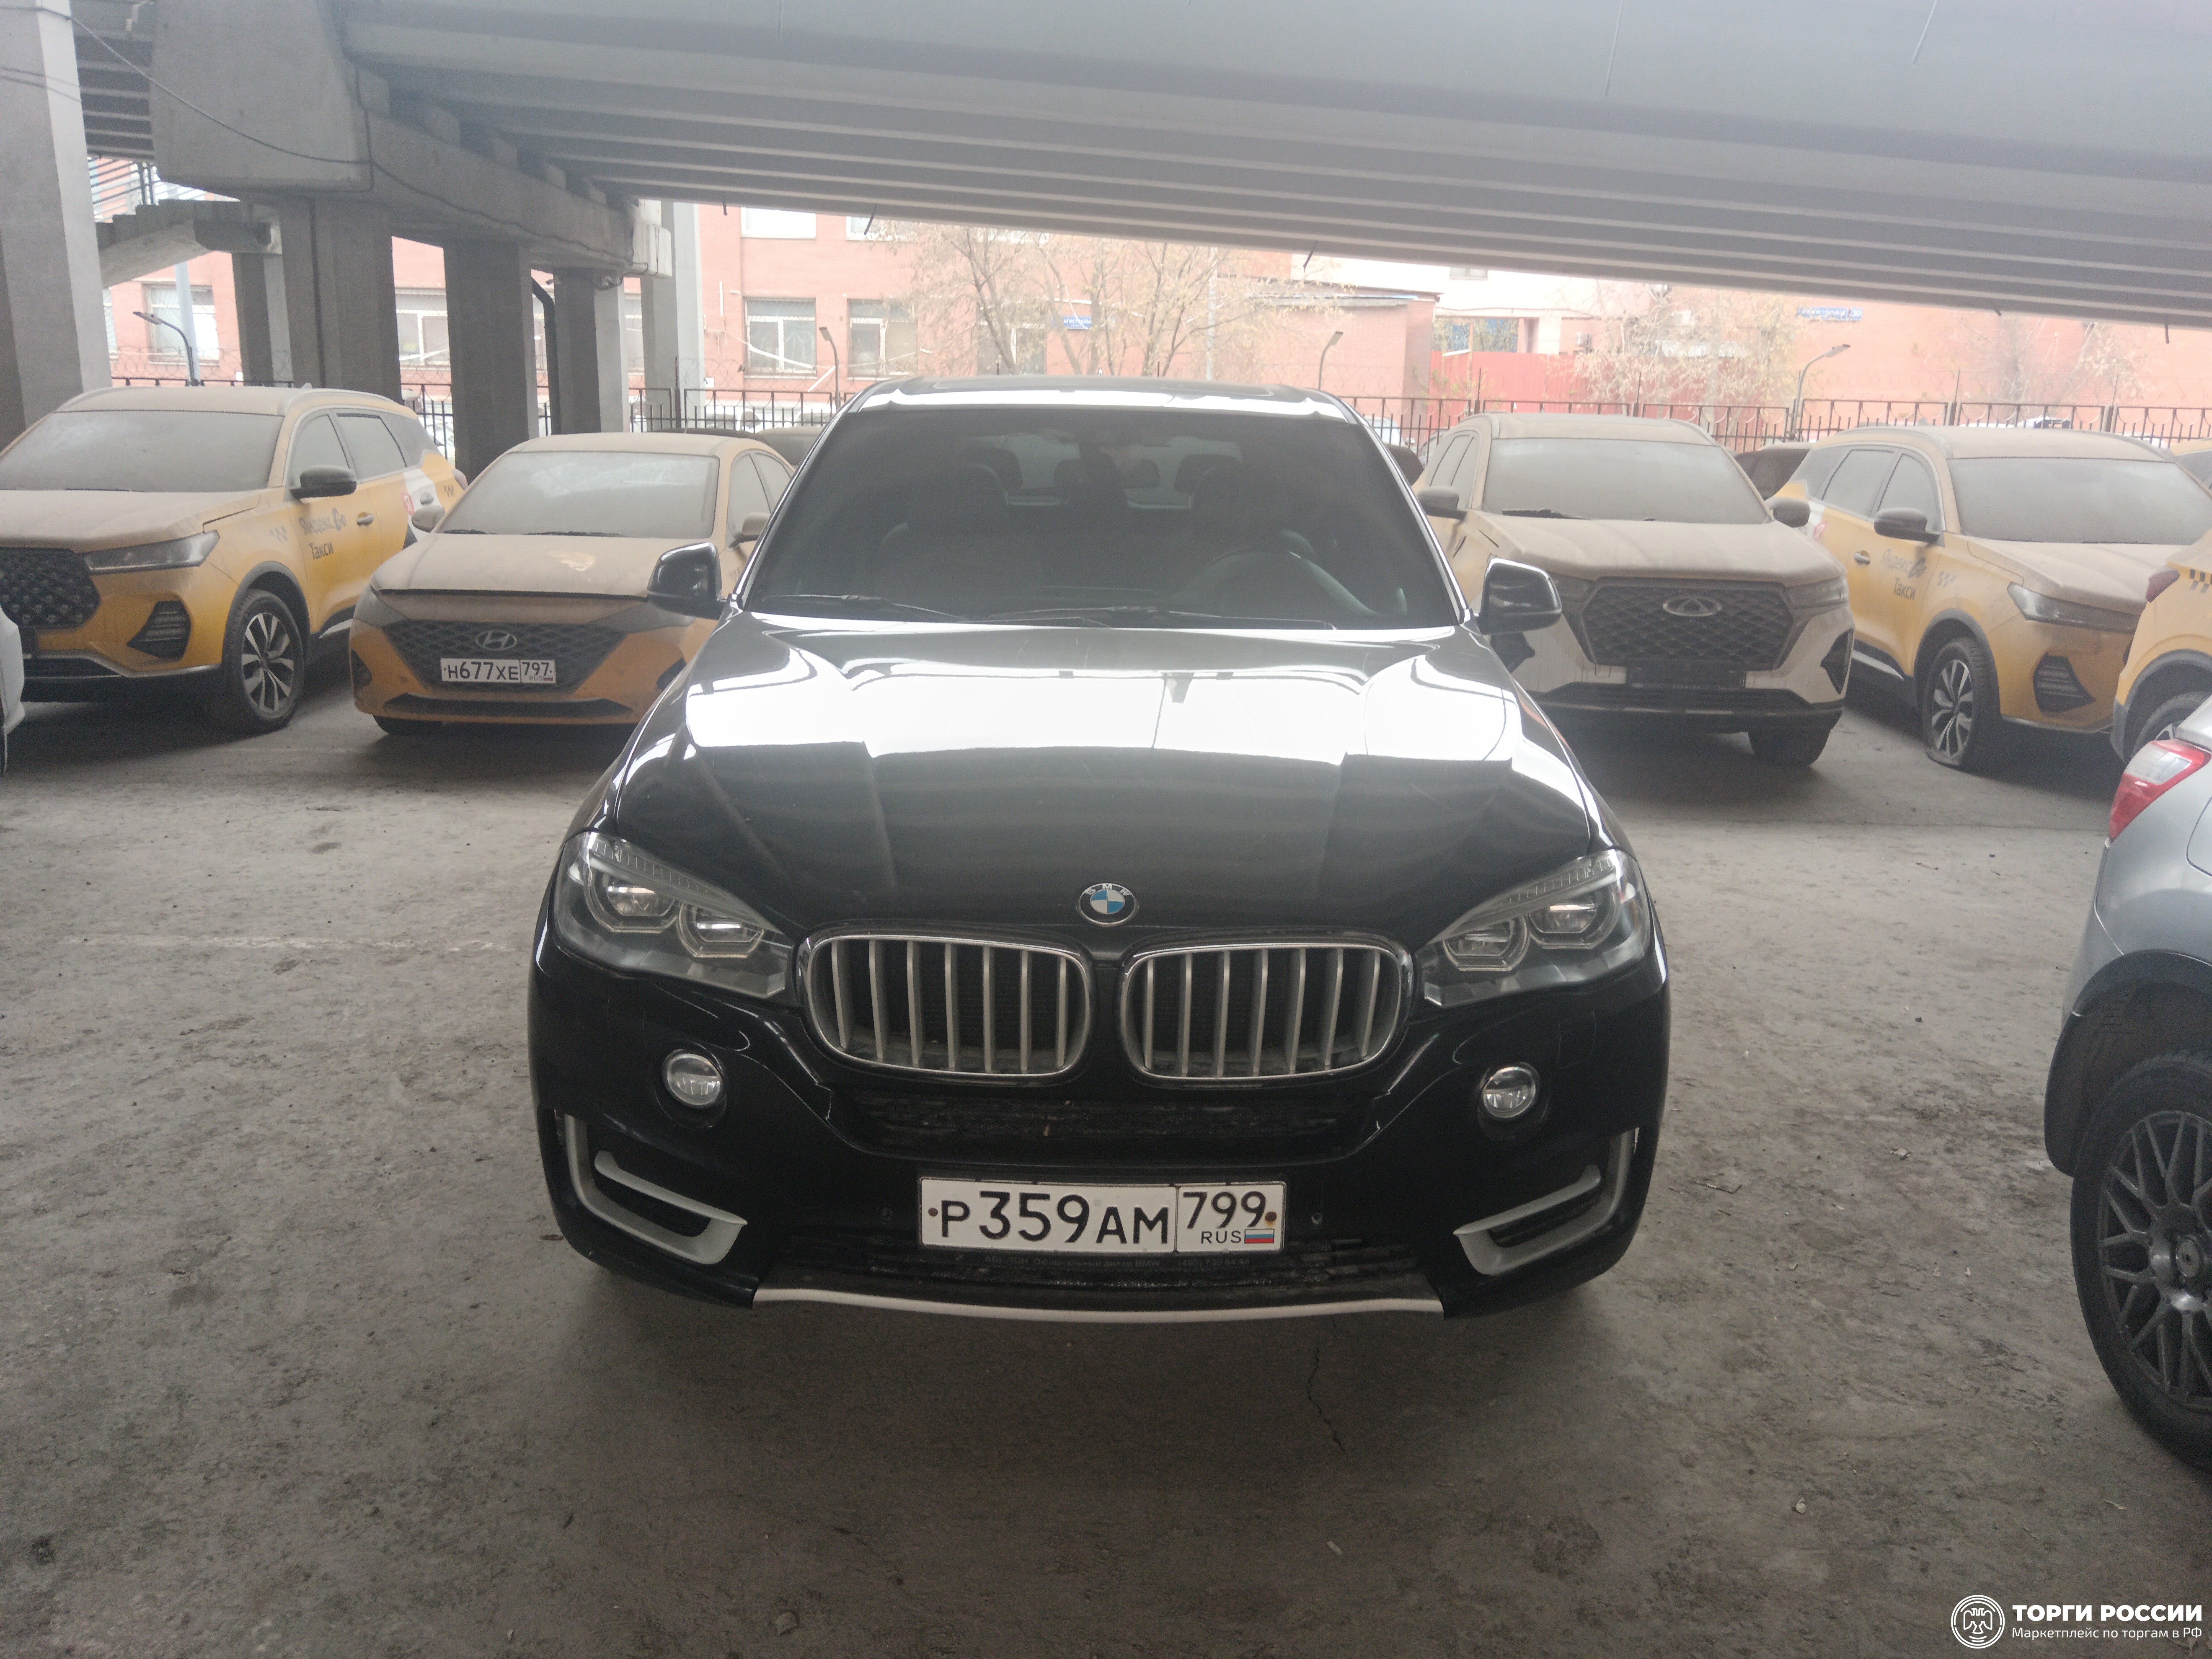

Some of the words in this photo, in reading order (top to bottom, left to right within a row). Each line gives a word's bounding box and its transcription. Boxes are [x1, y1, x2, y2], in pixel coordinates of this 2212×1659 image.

[299, 515, 335, 535] Яндекс
[309, 541, 333, 560] Такси
[1894, 577, 1916, 600] Такси
[448, 662, 518, 680] Н677ХЕ
[522, 662, 549, 676] 797
[1085, 884, 1131, 896] BMW
[941, 1190, 1168, 1244] Р359АМ
[1182, 1190, 1267, 1230] 799
[1201, 1230, 1242, 1244] RUS
